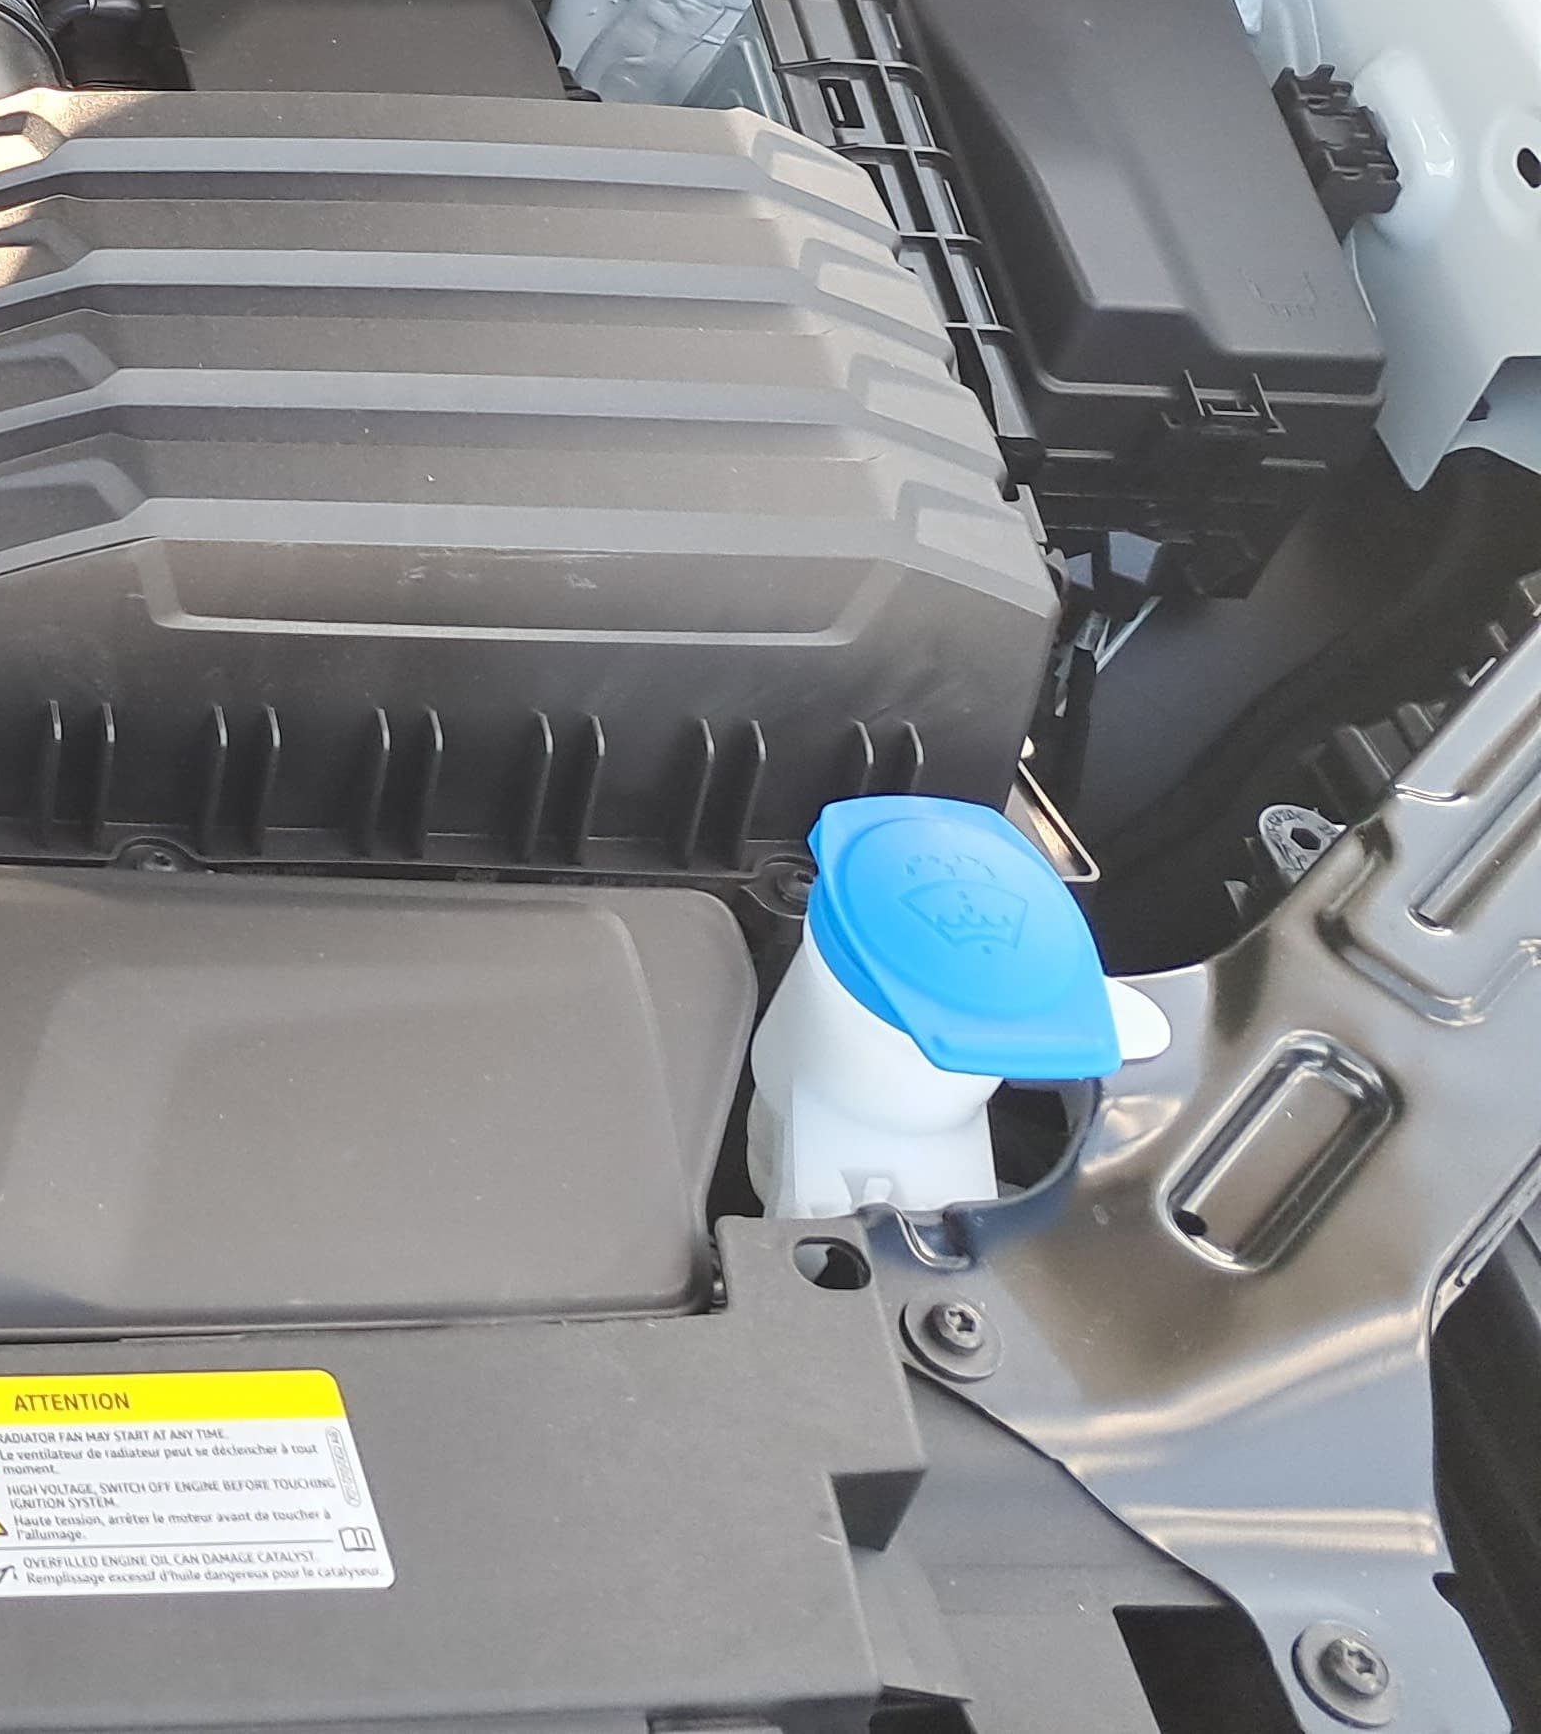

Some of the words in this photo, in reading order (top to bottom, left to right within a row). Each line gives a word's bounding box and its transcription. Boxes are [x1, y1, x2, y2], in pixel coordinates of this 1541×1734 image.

[15, 1392, 131, 1412] ATTENTION
[59, 1431, 83, 1443] FAN
[86, 1431, 110, 1442] MAY
[115, 1430, 149, 1442] START
[152, 1429, 166, 1441] AT
[170, 1429, 194, 1440] ANY
[0, 1449, 14, 1461] Le
[17, 1448, 83, 1460] ventilateur
[87, 1448, 102, 1459] de
[105, 1446, 160, 1458] radiateur
[163, 1447, 193, 1460] peut
[195, 1447, 209, 1457] se
[212, 1444, 277, 1457] déclencher
[291, 1443, 318, 1454] tout
[7, 1483, 38, 1496] HIGH
[100, 1481, 145, 1494] SWITCH
[148, 1481, 171, 1493] OFF
[175, 1480, 219, 1493] ENGINE
[222, 1479, 269, 1492] BEFORE
[273, 1477, 336, 1491] TOUCHING
[10, 1497, 65, 1510] IGNITION
[13, 1514, 52, 1526] Haute
[152, 1511, 165, 1524] le
[168, 1512, 213, 1523] moteur
[216, 1510, 251, 1522] avant
[254, 1509, 270, 1521] de
[272, 1508, 319, 1521] toucher
[23, 1555, 98, 1569] OVERFILLED
[101, 1554, 147, 1567] ENGINE
[150, 1553, 170, 1566] OIL
[173, 1552, 200, 1565] CAN
[203, 1551, 254, 1565] DAMAGE
[26, 1572, 105, 1586] Remplissage
[108, 1570, 156, 1583] excessif
[204, 1568, 268, 1583] dangereux
[272, 1568, 302, 1581] pour
[304, 1565, 316, 1578] le
